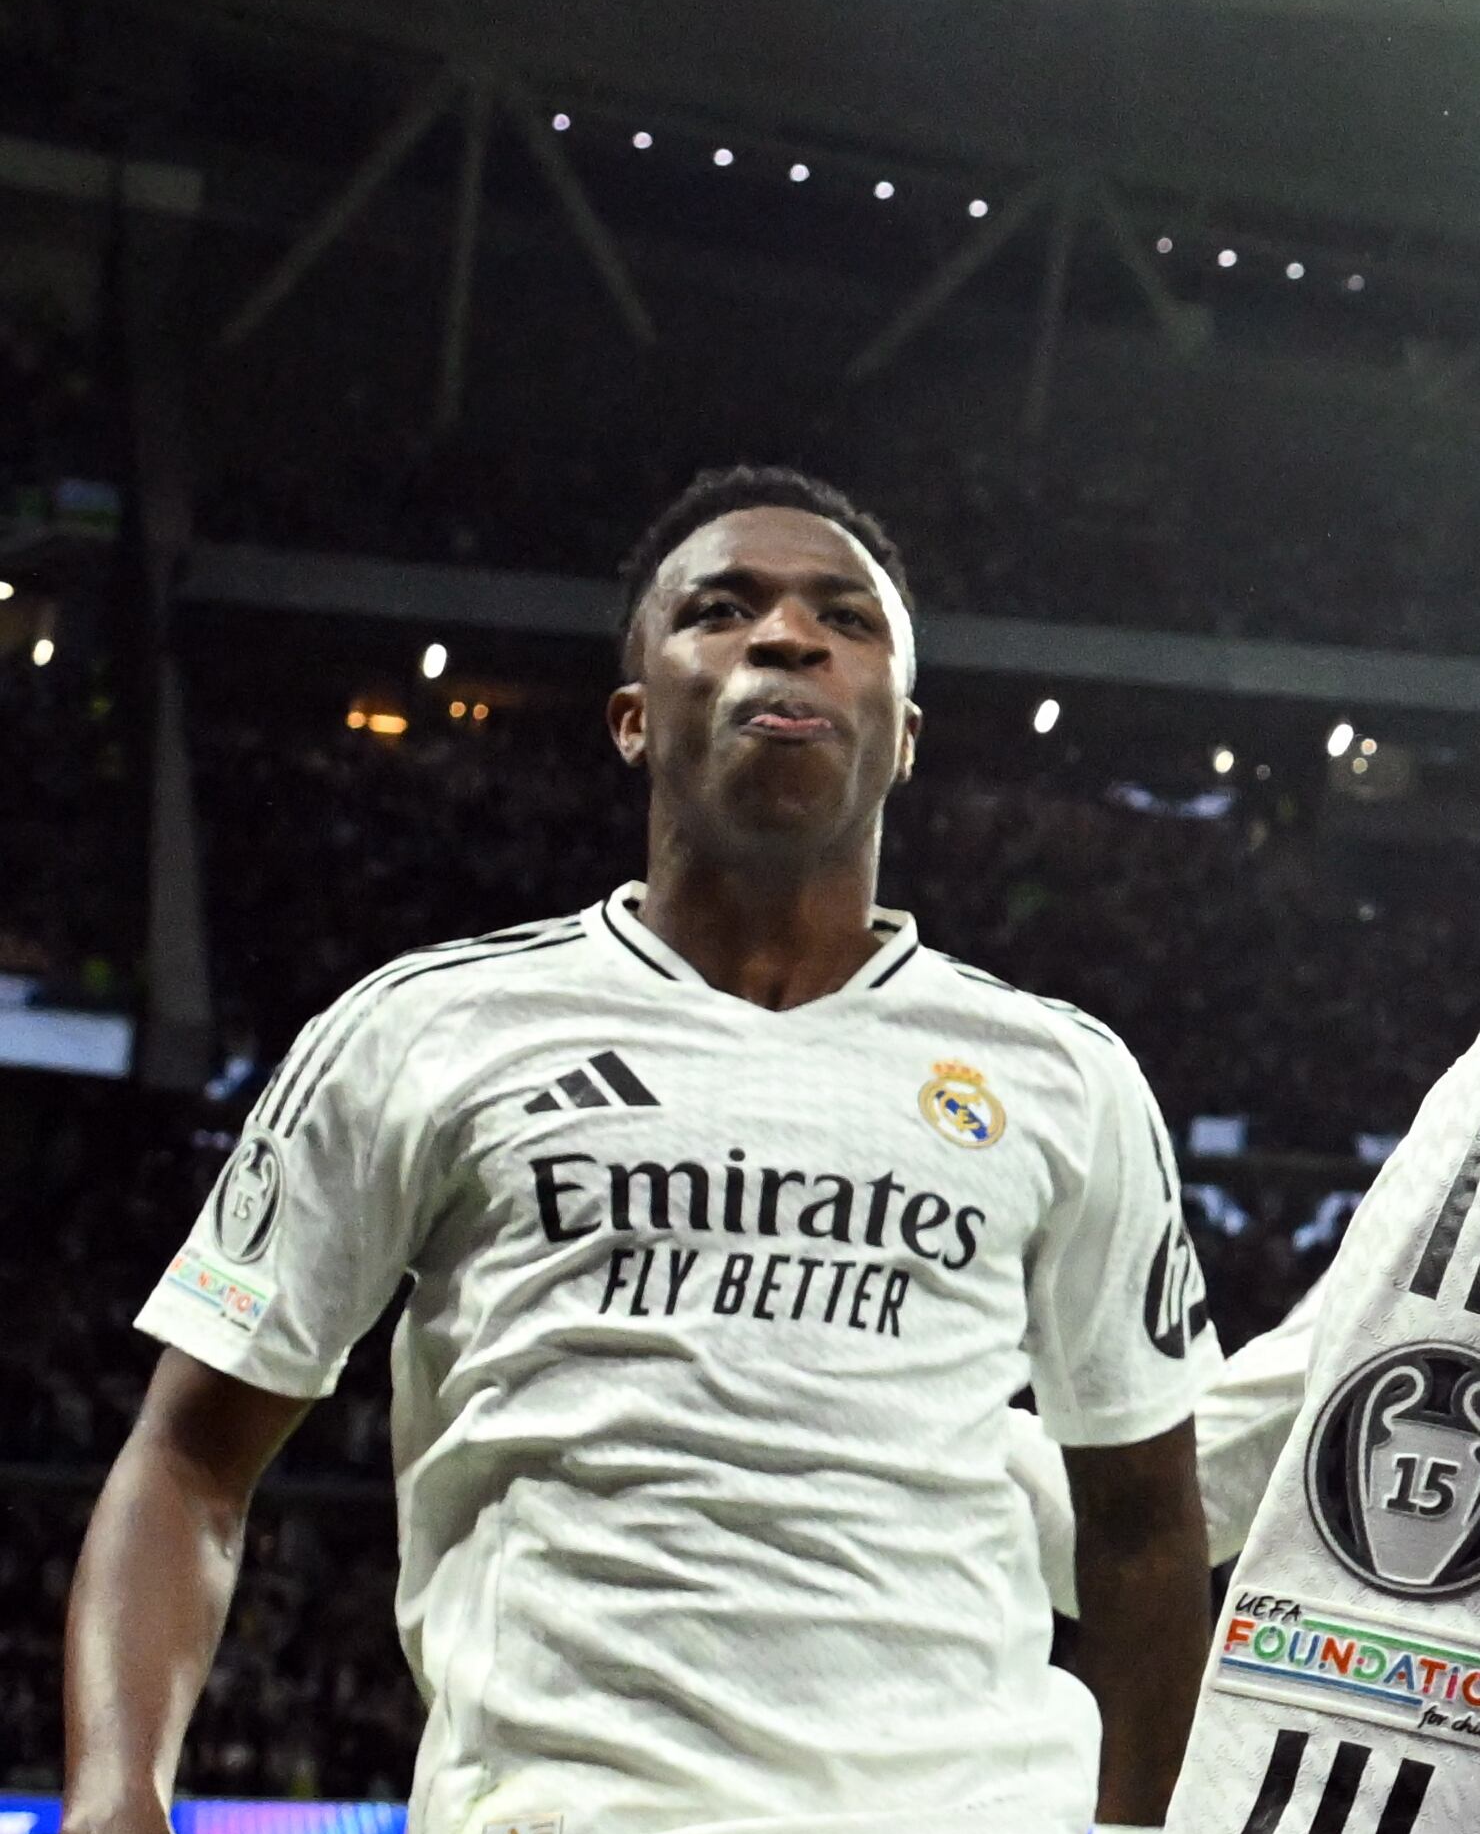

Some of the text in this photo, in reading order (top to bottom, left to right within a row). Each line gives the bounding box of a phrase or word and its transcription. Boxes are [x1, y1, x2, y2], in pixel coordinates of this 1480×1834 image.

[233, 1187, 254, 1220] 15
[529, 1148, 986, 1271] Emirates
[599, 1248, 910, 1337] FLY BETTER
[1386, 1456, 1458, 1517] 15
[1235, 1591, 1302, 1622] UEFA
[1418, 1705, 1449, 1729] for
